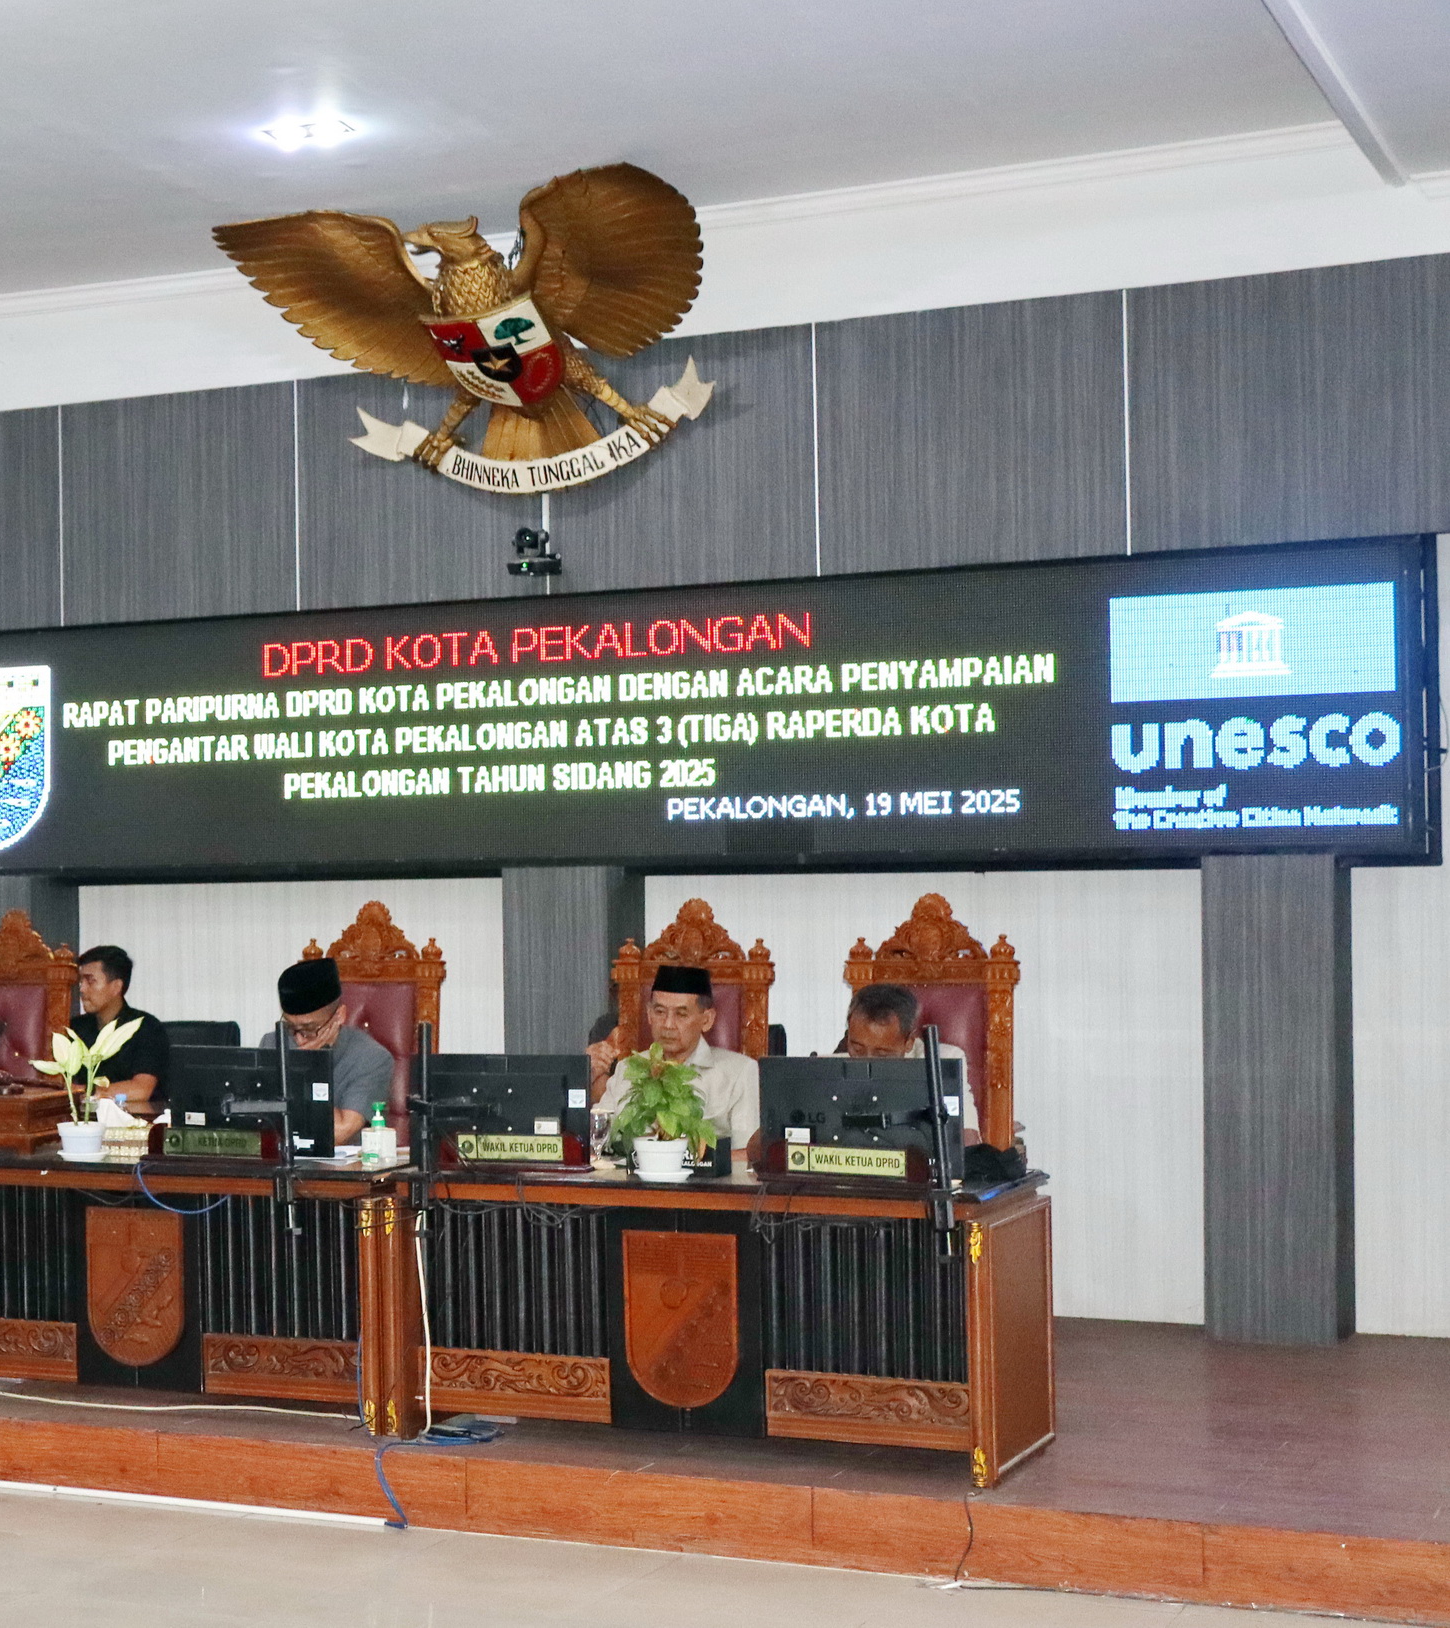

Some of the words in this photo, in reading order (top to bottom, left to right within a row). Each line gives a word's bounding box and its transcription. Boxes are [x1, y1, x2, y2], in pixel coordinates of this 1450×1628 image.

[452, 454, 519, 490] BHINNEKA
[527, 451, 605, 487] TUNGGAL
[609, 431, 641, 462] IKA
[262, 638, 375, 678] DPRD
[384, 630, 499, 670] KOTA
[510, 612, 811, 663] PEKALONGAN
[63, 699, 140, 728] RAPAT
[145, 692, 280, 724] PARIPURNA
[286, 688, 353, 718] DPRD
[359, 684, 430, 714] KOTA
[436, 675, 612, 711] PEKALONGAN
[618, 669, 729, 702] DENGAN
[736, 664, 833, 697] ACARA
[840, 653, 1055, 692] PENYAMPAIAN
[108, 734, 250, 766] PENGANTAR
[254, 731, 313, 760] WALI
[319, 728, 390, 757] KOTA
[395, 720, 569, 754] PEKALONGAN
[575, 717, 649, 747] ATAS
[656, 716, 672, 744] 3
[677, 712, 759, 748] (TIGA)
[766, 706, 903, 741] RAPERDA
[909, 703, 996, 735] KOTA
[1110, 711, 1402, 774] unesco
[284, 767, 450, 800] PEKALONGAN
[457, 764, 546, 794] TAHUN
[552, 760, 652, 791] SIDANG
[659, 758, 716, 788] 2025
[666, 794, 856, 821] PEKALONGAN,
[865, 792, 893, 817] 19
[900, 791, 953, 816] MEI
[960, 789, 1022, 815] 2025
[808, 1112, 826, 1124] LG
[198, 1137, 222, 1148] KETUA
[224, 1138, 247, 1149] DPRD
[482, 1142, 507, 1152] WAKIL
[509, 1142, 534, 1153] KETUA
[536, 1143, 558, 1154] DPRD
[815, 1154, 843, 1166] WAKIL
[845, 1155, 873, 1167] KETUA
[876, 1157, 900, 1169] DPRD
